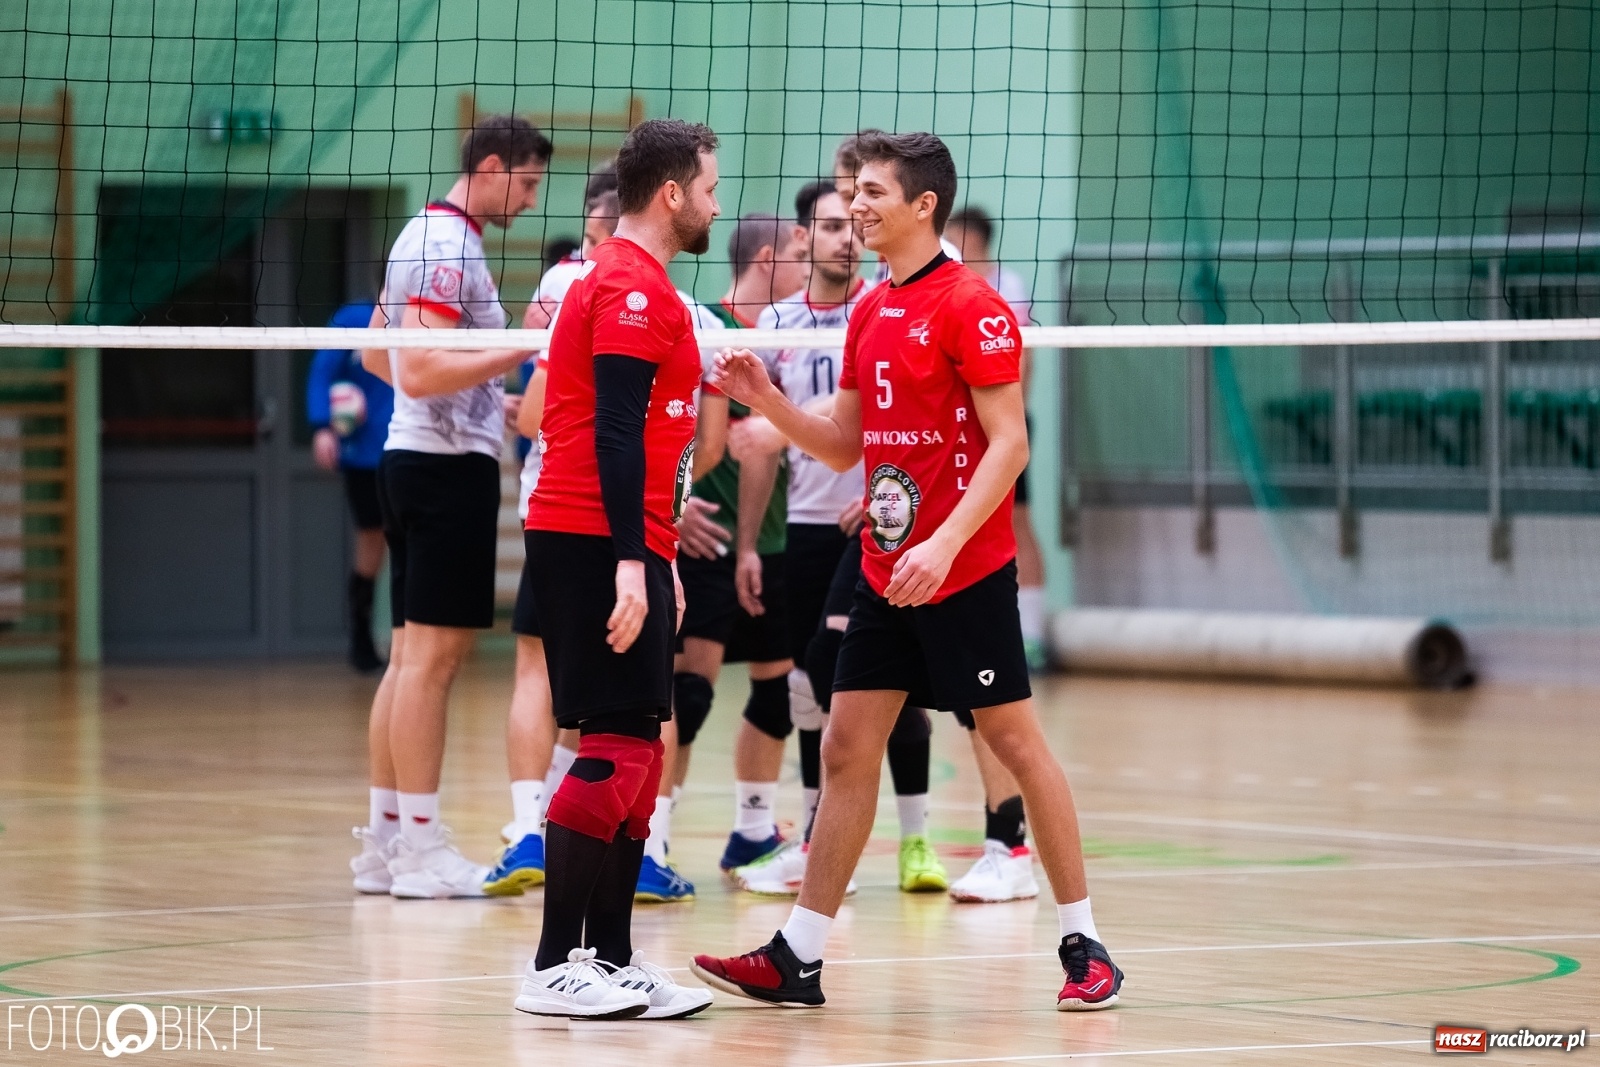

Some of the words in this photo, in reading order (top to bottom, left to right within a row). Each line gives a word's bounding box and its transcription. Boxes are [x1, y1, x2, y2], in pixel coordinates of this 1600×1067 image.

[980, 335, 1015, 351] radlin
[875, 361, 893, 409] 5
[882, 430, 919, 446] KOKS
[921, 430, 944, 445] SA
[1066, 936, 1080, 946] NIKE
